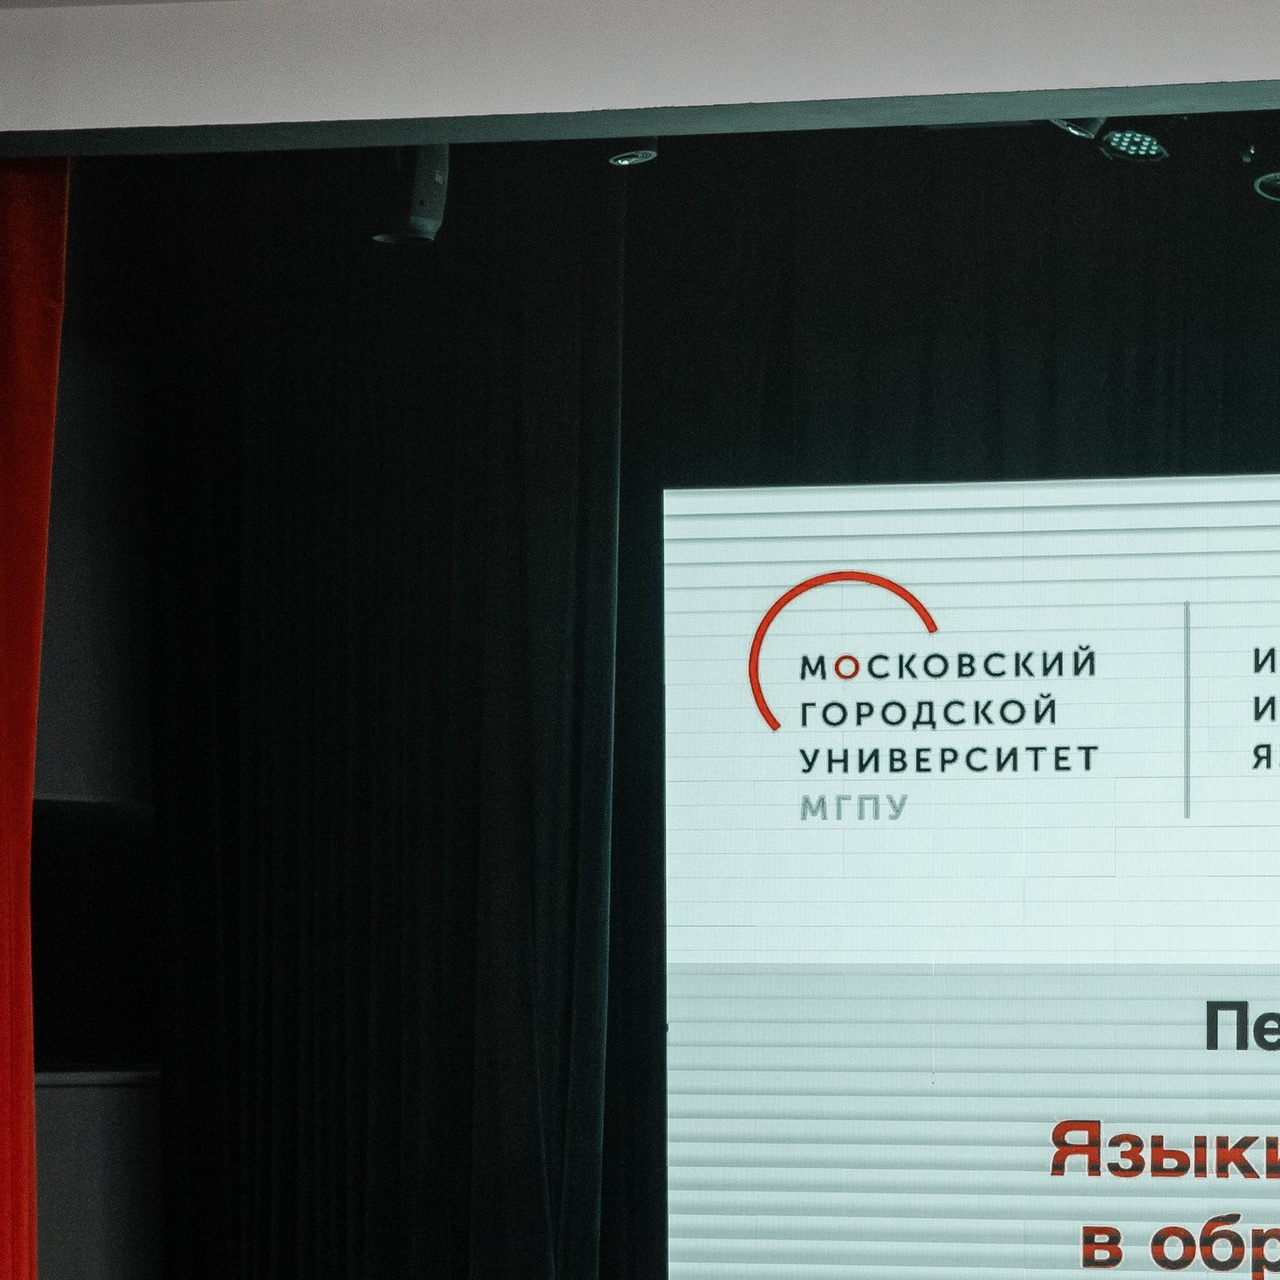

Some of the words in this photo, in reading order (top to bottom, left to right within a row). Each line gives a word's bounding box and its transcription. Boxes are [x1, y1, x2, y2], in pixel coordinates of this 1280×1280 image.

[800, 645, 1096, 680] МОСКОВСКИЙ
[801, 693, 1056, 729] ГОРОДСКОЙ
[800, 746, 1098, 773] УНИВЕРСИТЕТ
[800, 794, 908, 820] МГПУ
[1081, 1225, 1123, 1268] в
